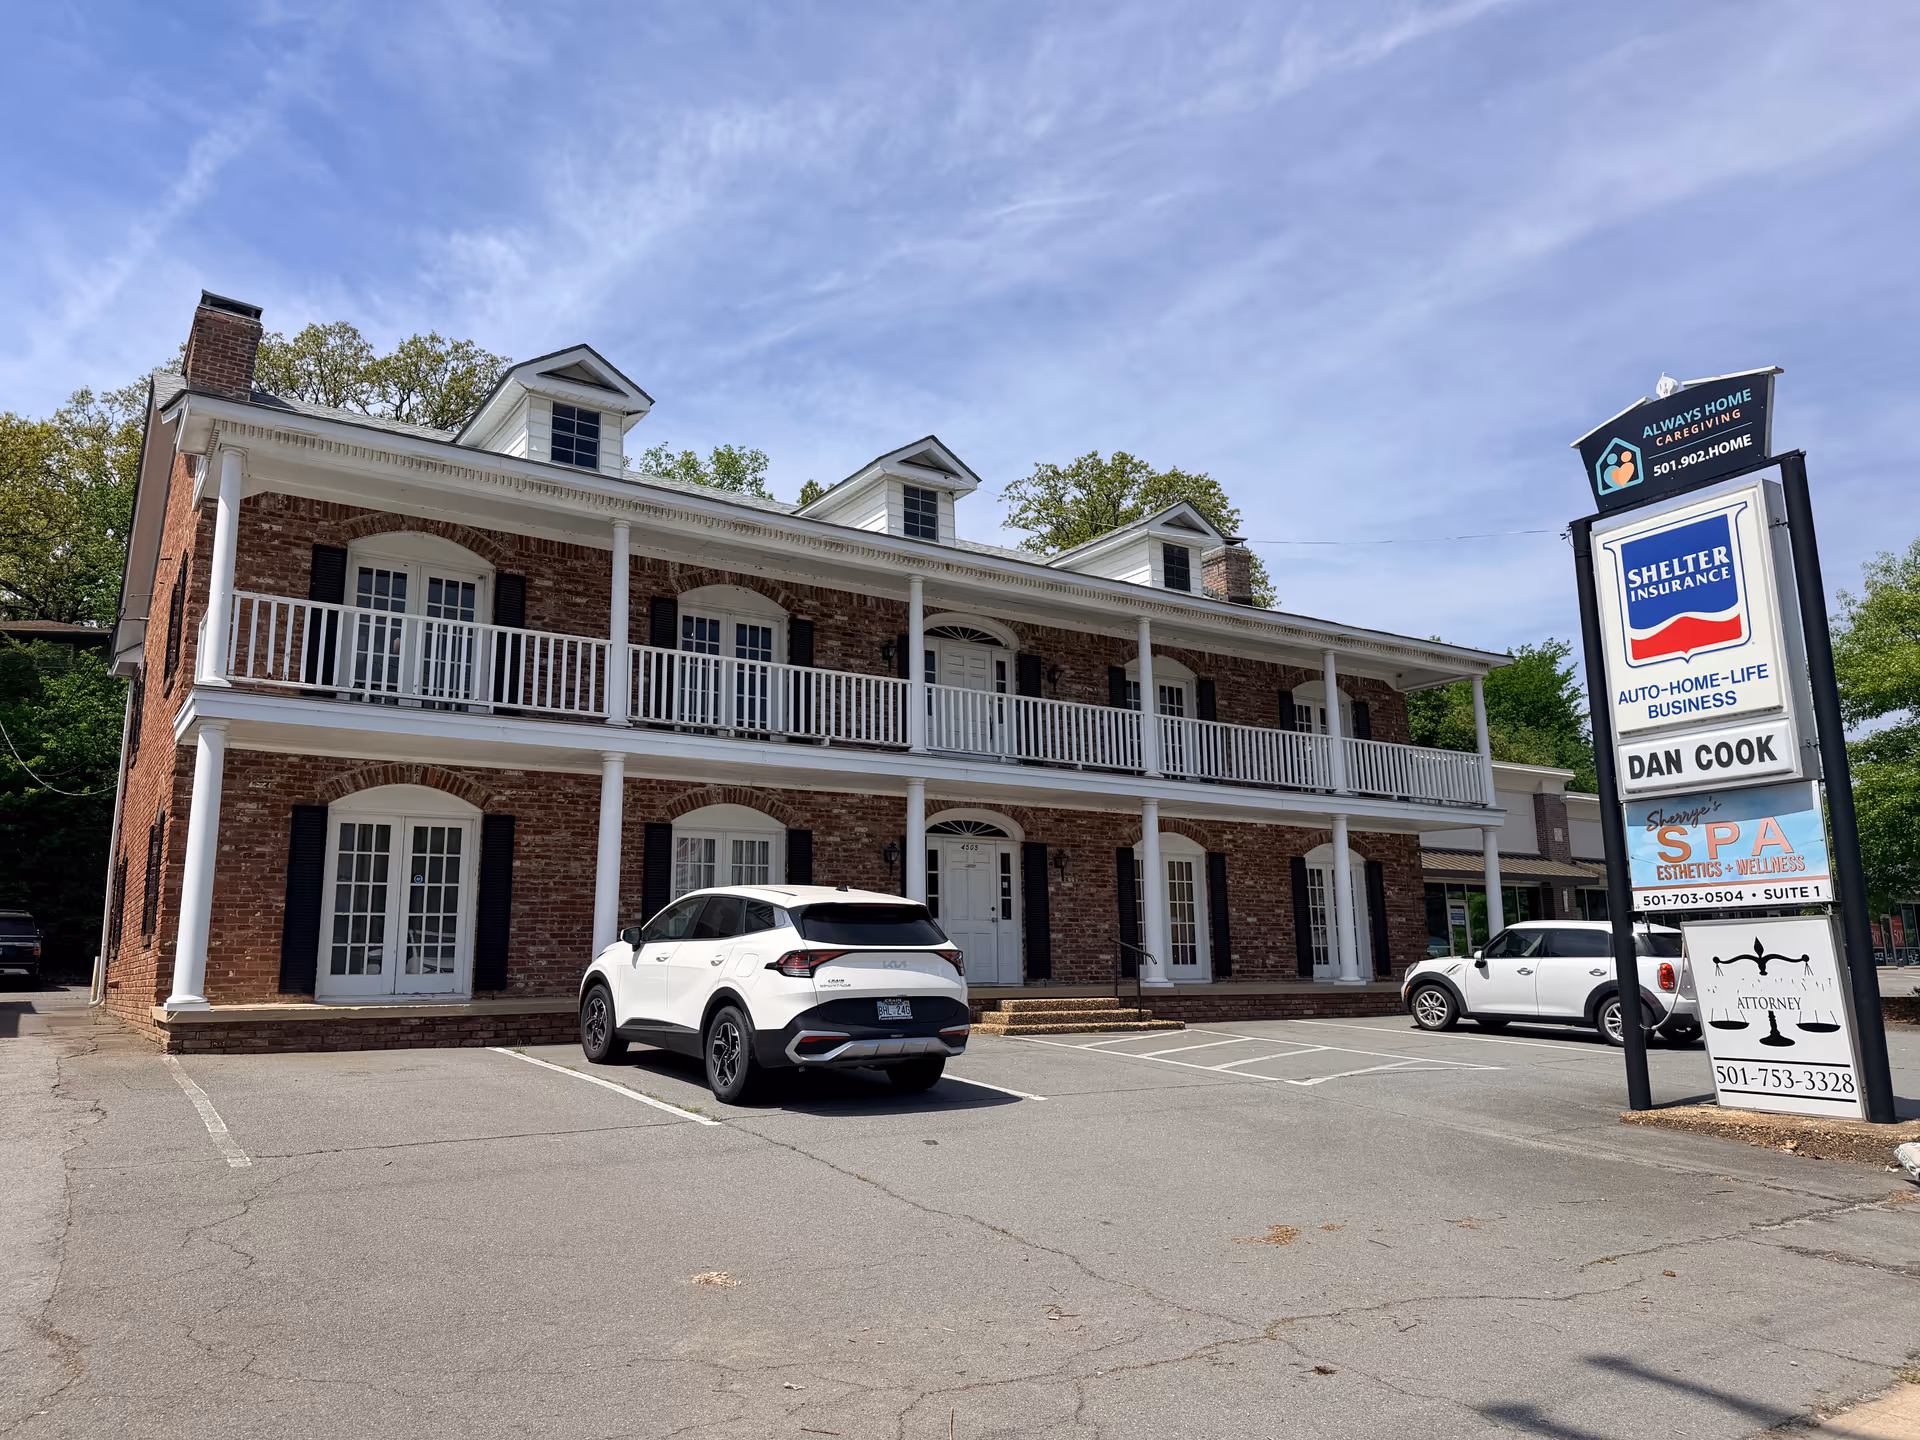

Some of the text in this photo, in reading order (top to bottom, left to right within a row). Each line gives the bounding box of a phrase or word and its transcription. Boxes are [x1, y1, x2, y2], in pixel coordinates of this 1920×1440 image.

[1642, 388, 1752, 439] ALWAYS HOME
[1656, 408, 1741, 446] CAREGIVING
[1653, 433, 1753, 477] 501.902.HOME
[1627, 545, 1730, 588] SHELTER
[1630, 566, 1731, 602] INSURANCE
[1618, 663, 1769, 705] AUTO-HOME-LIFE
[1648, 690, 1737, 719] BUSINESS
[1628, 734, 1778, 780] DAN COOK
[1646, 795, 1722, 832] Sherrye's
[1656, 816, 1795, 864] SPA
[1656, 861, 1722, 881] ESTHETICS
[1735, 855, 1806, 876] WELLNESS
[1643, 890, 1744, 906] 501-703-0504
[1764, 886, 1810, 899] SUITE
[1813, 885, 1821, 897] 1
[1737, 996, 1801, 1010] ATTORNEY
[1716, 1066, 1855, 1093] 501-753-3328
